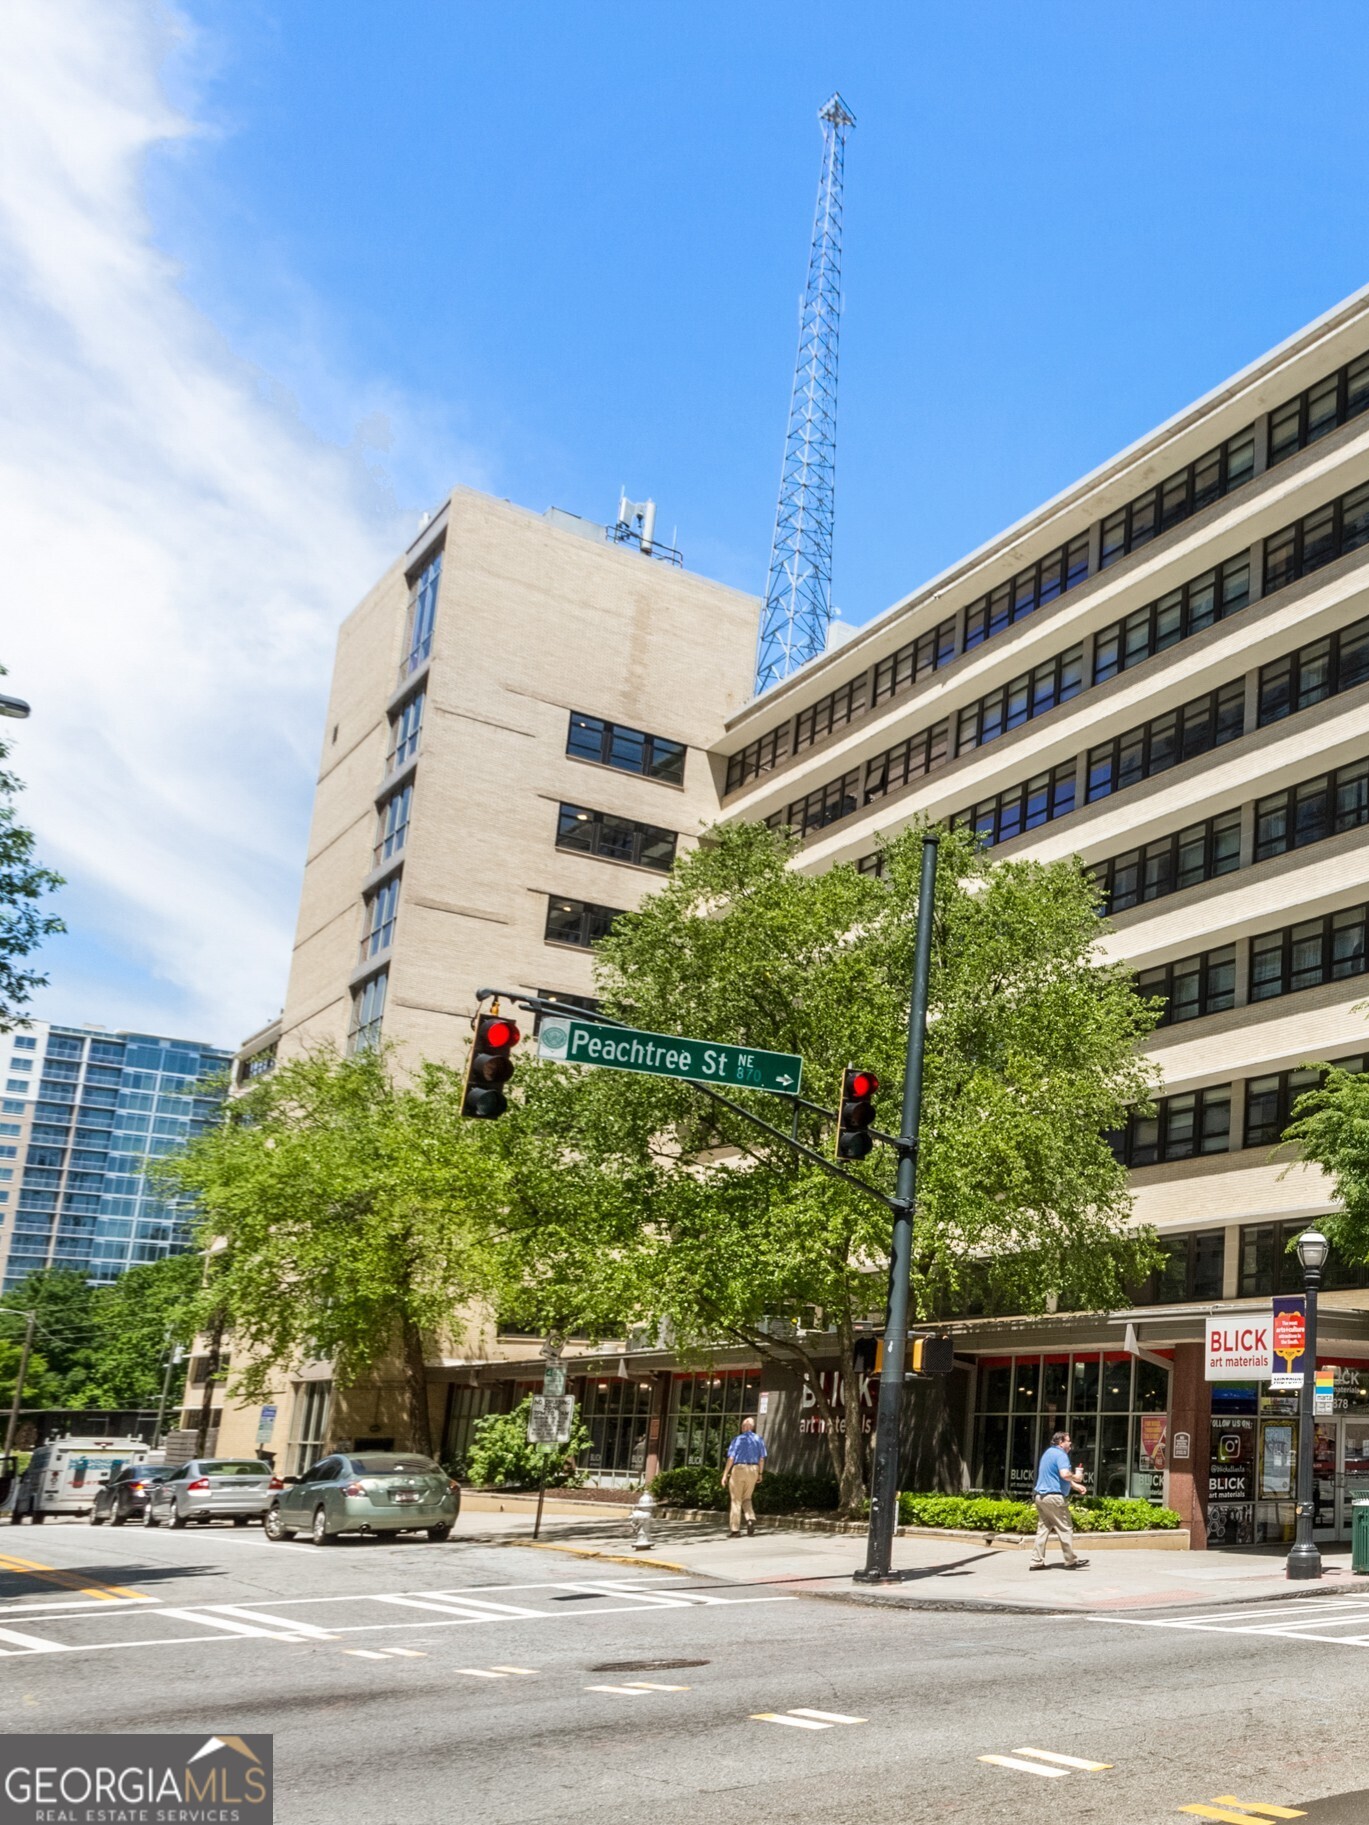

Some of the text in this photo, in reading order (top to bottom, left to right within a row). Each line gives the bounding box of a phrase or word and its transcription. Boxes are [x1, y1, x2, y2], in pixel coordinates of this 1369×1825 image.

[571, 1029, 755, 1077] Peachtree St NE
[1211, 1328, 1268, 1352] BLICK
[1210, 1354, 1269, 1367] art materials
[800, 1416, 816, 1433] art
[1010, 1469, 1034, 1480] BLICK
[1209, 1478, 1246, 1490] BLICK
